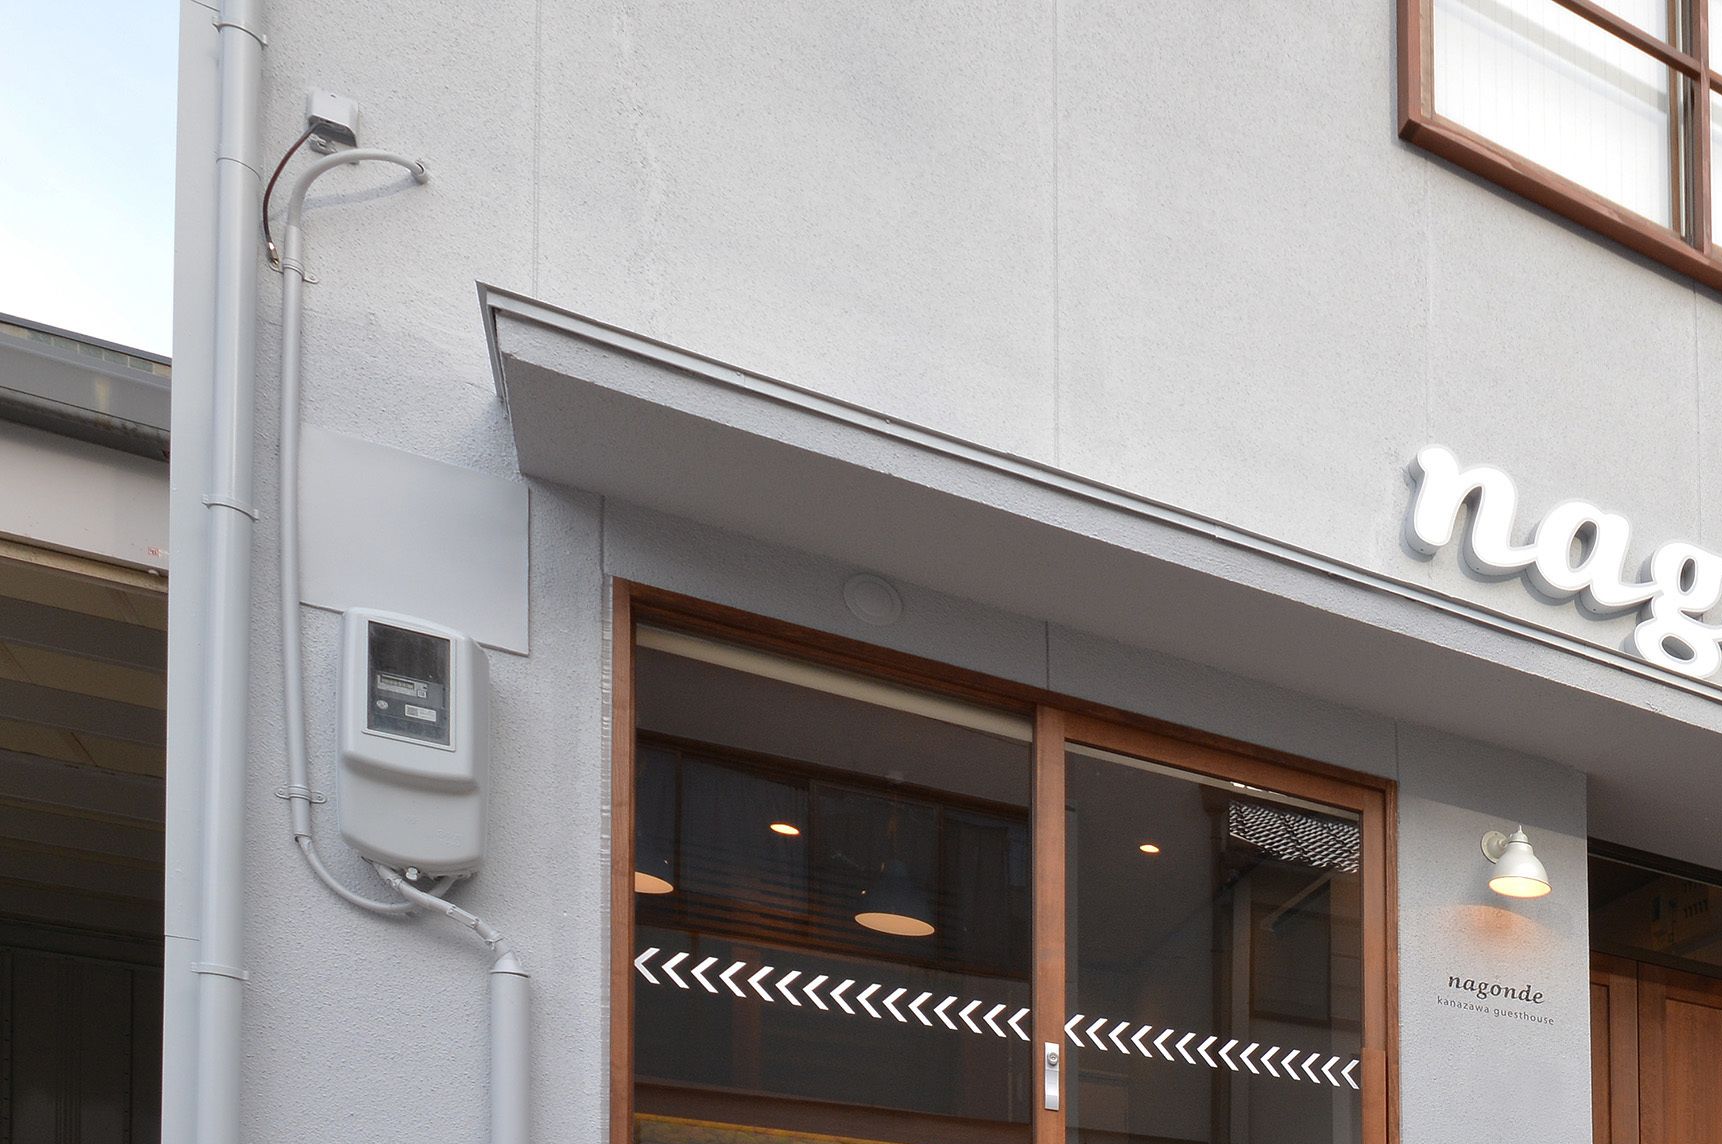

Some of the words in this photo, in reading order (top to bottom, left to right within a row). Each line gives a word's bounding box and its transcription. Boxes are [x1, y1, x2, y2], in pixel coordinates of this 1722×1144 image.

[1449, 975, 1545, 1004] nagonde
[1437, 996, 1490, 1014] kanazawa
[1493, 1007, 1555, 1026] guesthouse
